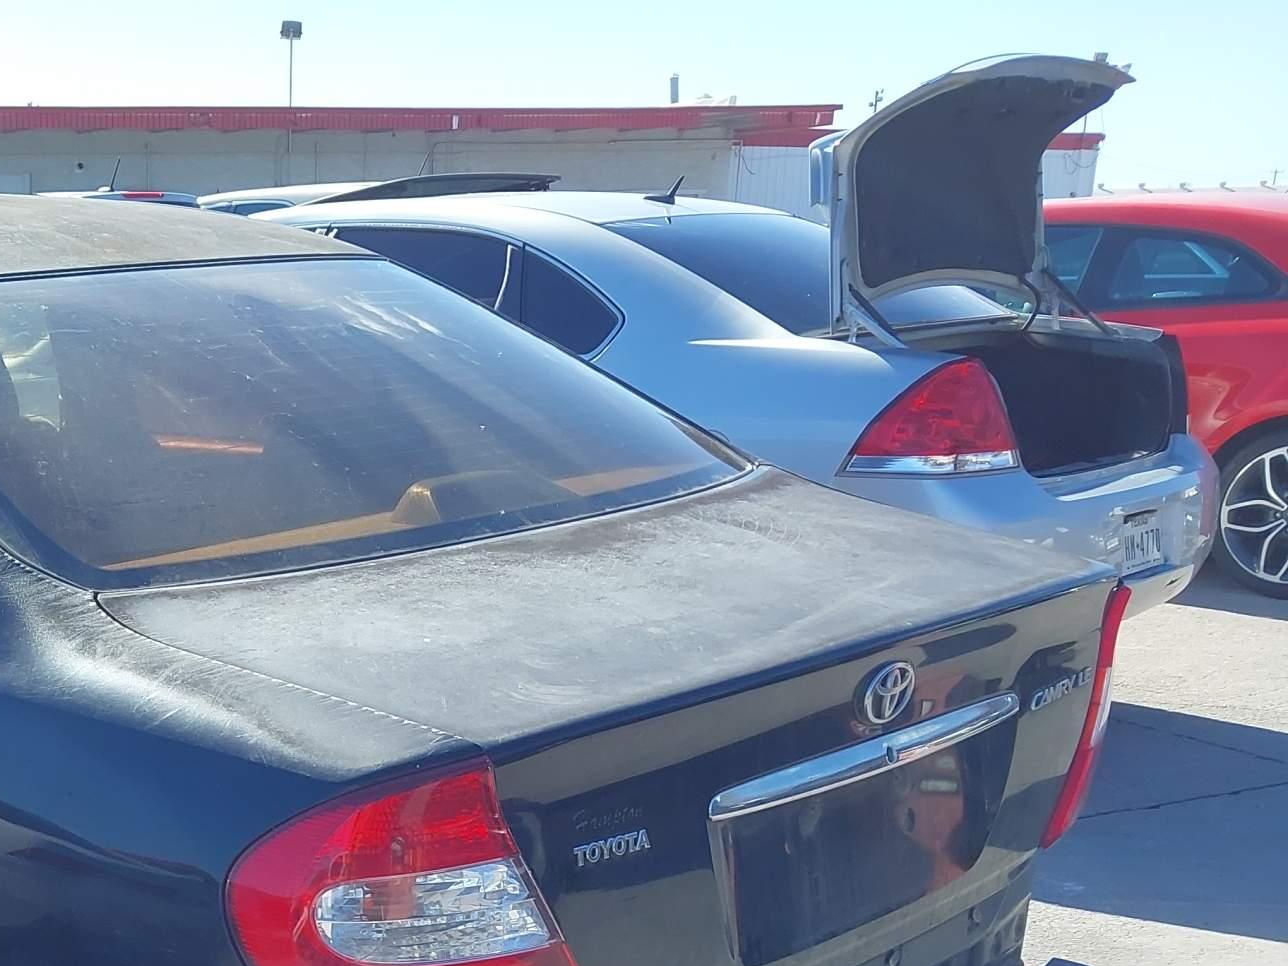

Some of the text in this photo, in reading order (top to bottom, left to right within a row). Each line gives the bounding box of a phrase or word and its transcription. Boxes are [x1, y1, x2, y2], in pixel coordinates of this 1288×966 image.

[1031, 667, 1092, 711] CAMRY LE
[573, 829, 651, 867] TOYOTA
